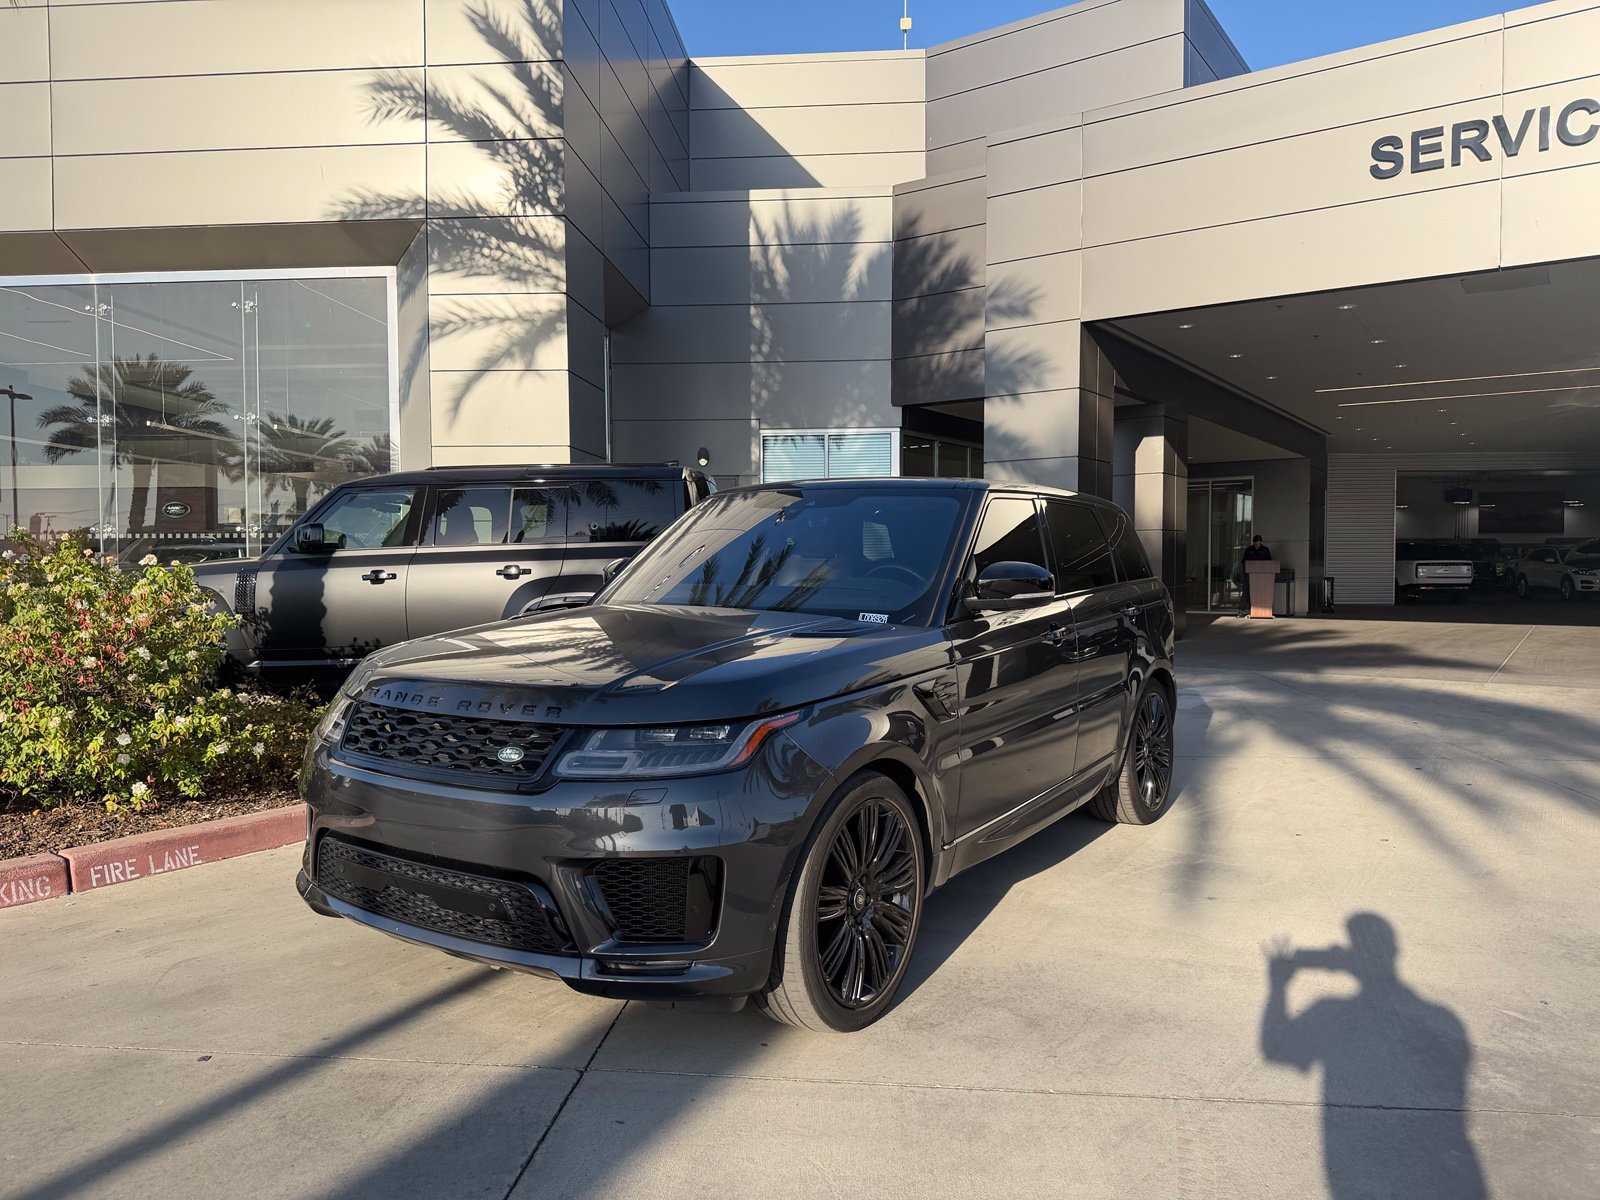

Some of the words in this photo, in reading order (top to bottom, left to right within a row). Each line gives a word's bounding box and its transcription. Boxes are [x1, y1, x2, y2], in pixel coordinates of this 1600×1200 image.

[1369, 98, 1600, 180] SERVIC
[367, 686, 443, 707] RANGE
[456, 699, 564, 719] ROVER
[90, 858, 140, 887] FIRE
[148, 845, 203, 874] LANE
